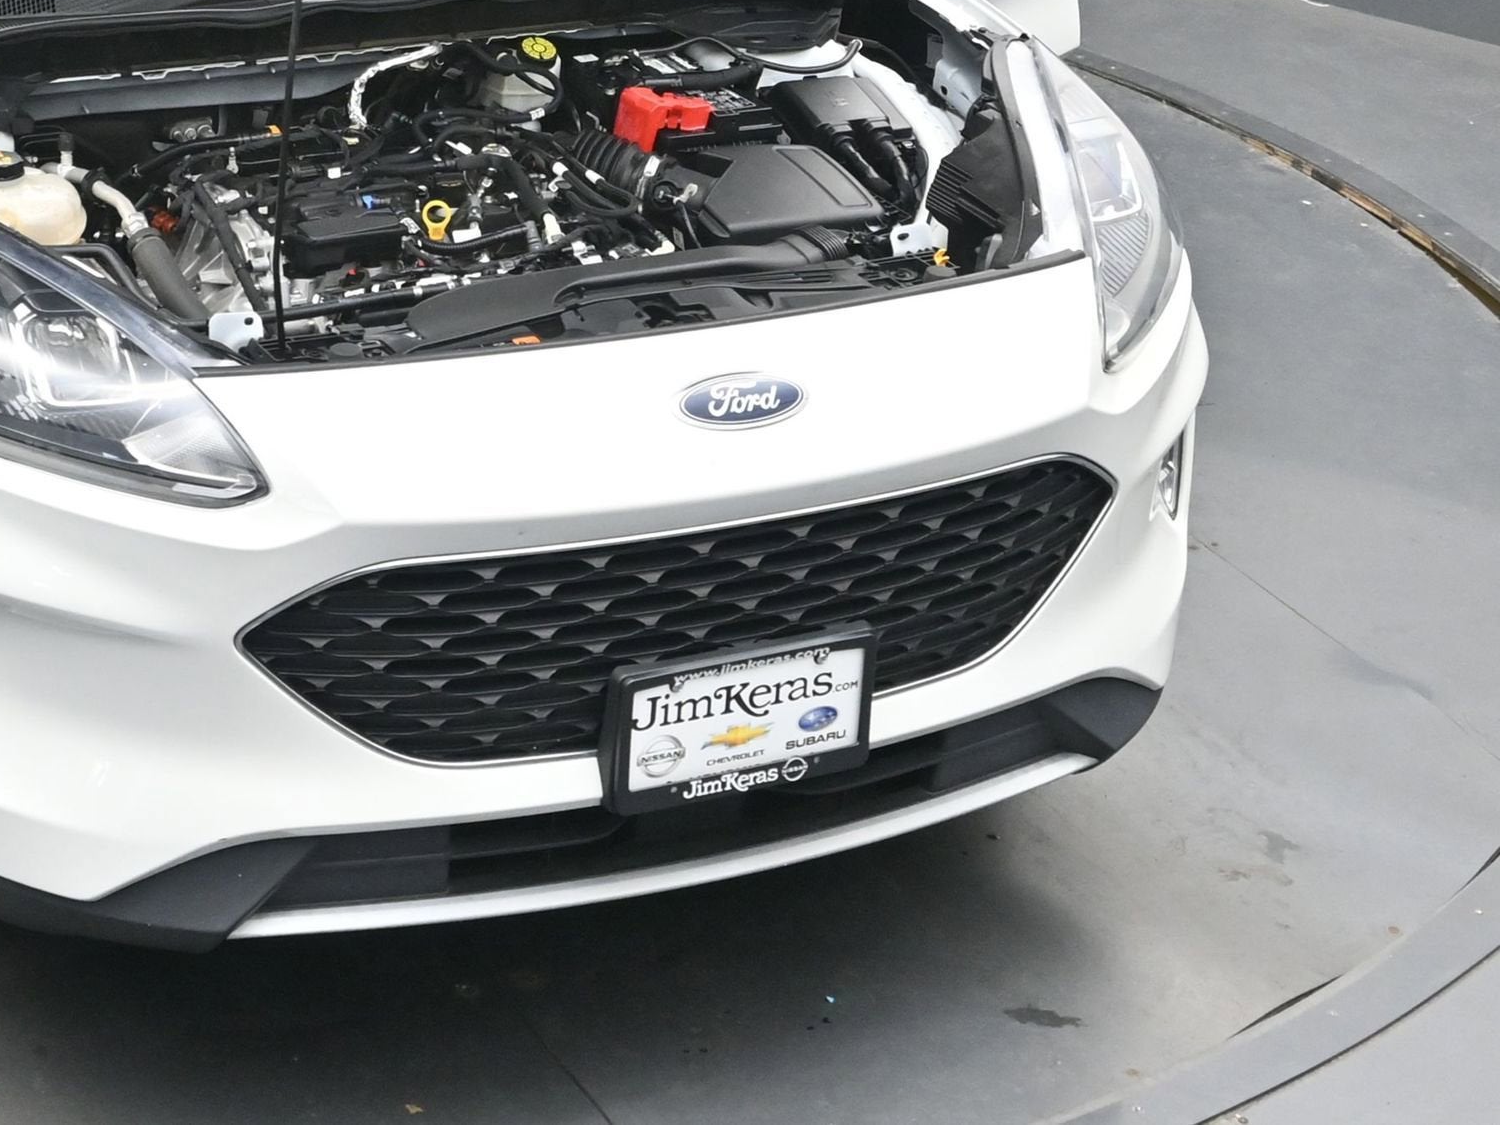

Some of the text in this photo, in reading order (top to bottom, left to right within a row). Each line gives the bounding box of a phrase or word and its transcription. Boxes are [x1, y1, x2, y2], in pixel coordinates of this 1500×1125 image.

[708, 381, 781, 417] Ford
[673, 646, 830, 684] www.jimkeras.com
[785, 730, 846, 750] SUBARU
[640, 749, 683, 764] NISSAN
[706, 749, 765, 766] CHEVROLET
